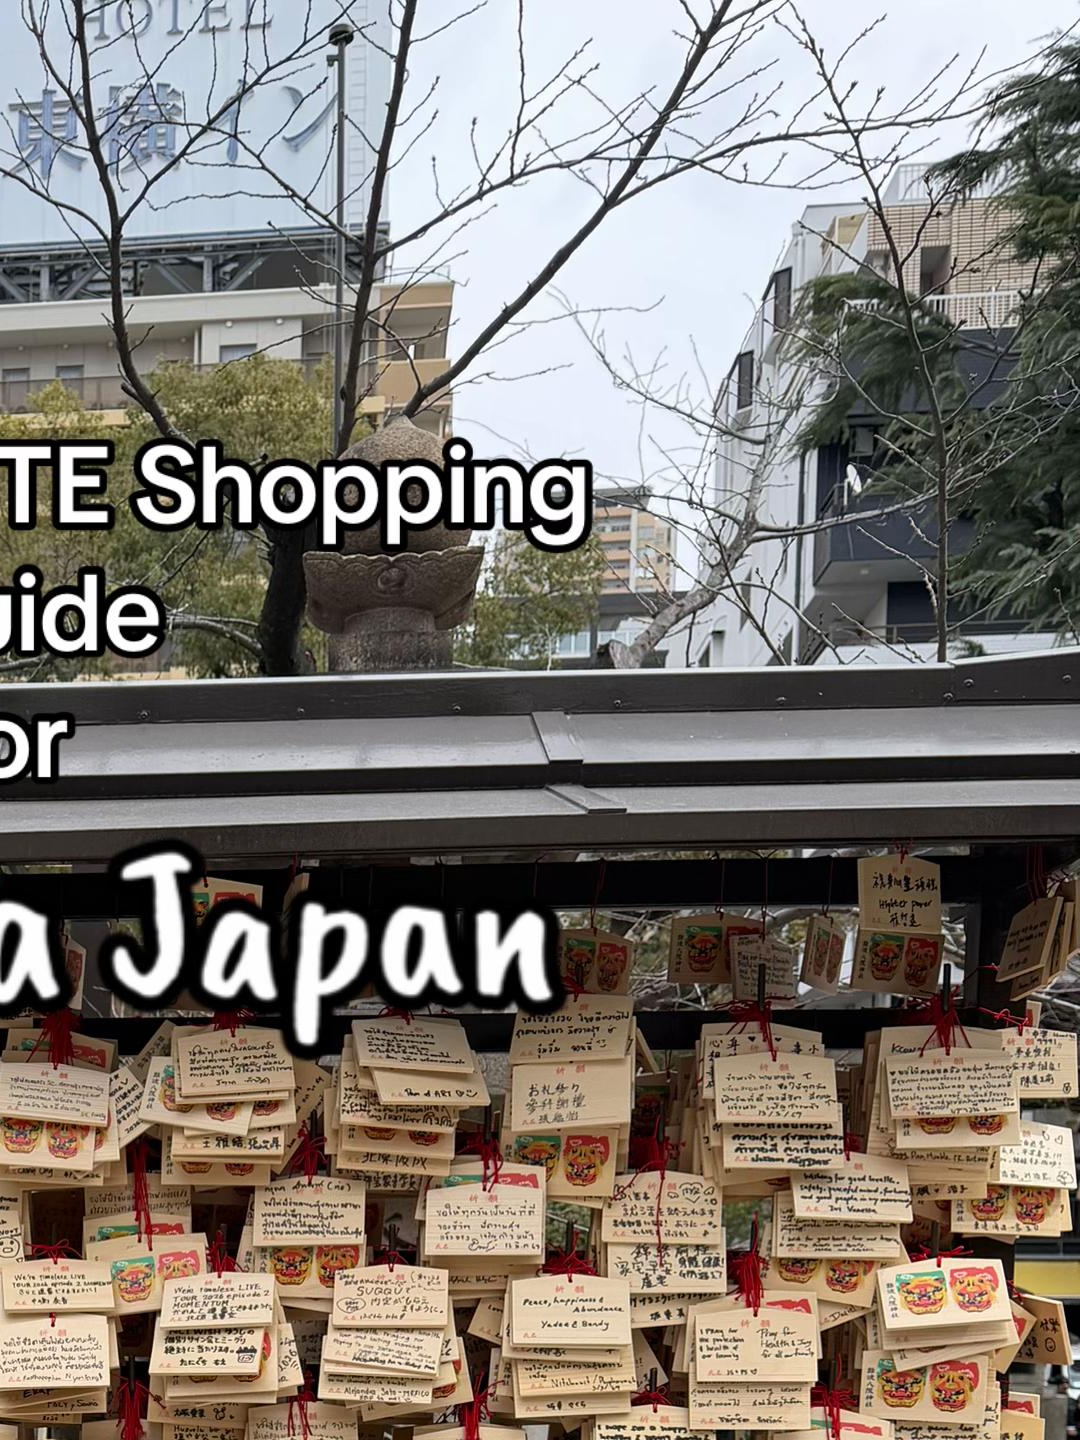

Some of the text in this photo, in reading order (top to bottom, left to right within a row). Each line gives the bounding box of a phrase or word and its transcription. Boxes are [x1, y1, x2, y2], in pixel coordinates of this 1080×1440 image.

[2, 80, 340, 178] 東横イン
[238, 1283, 261, 1291] LIVE
[174, 1294, 198, 1302] TOUR
[172, 1300, 229, 1309] MOMENTUM
